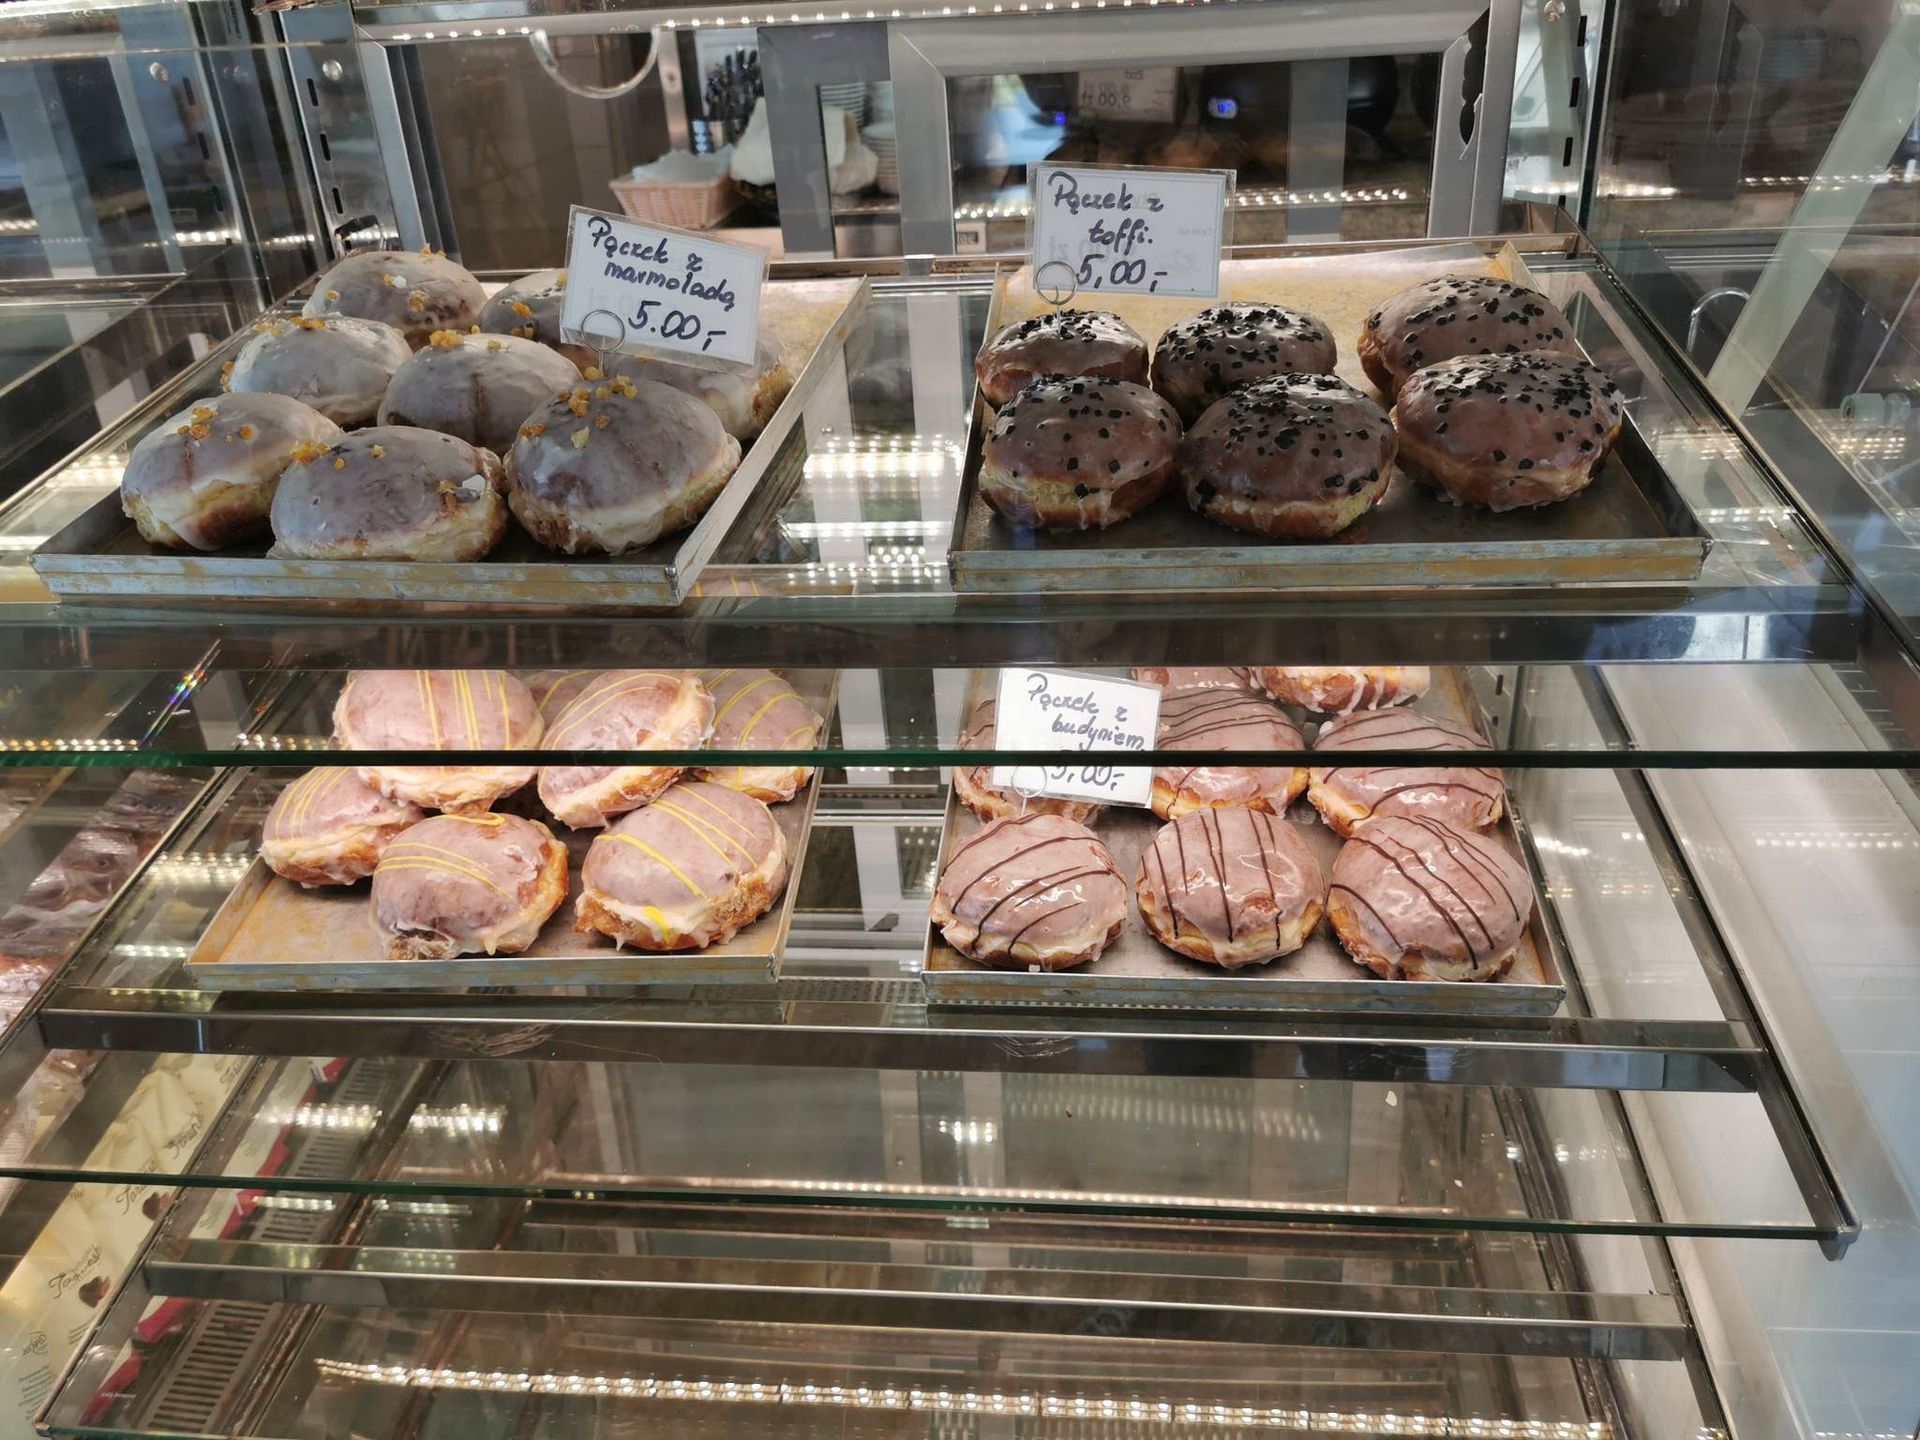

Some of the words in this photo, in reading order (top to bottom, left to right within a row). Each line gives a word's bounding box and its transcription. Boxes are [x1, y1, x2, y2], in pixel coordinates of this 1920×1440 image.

[1047, 170, 1134, 215] Pączek
[587, 216, 669, 264] Pączek
[604, 260, 735, 312] marmoladą
[1026, 673, 1099, 714] Pączek
